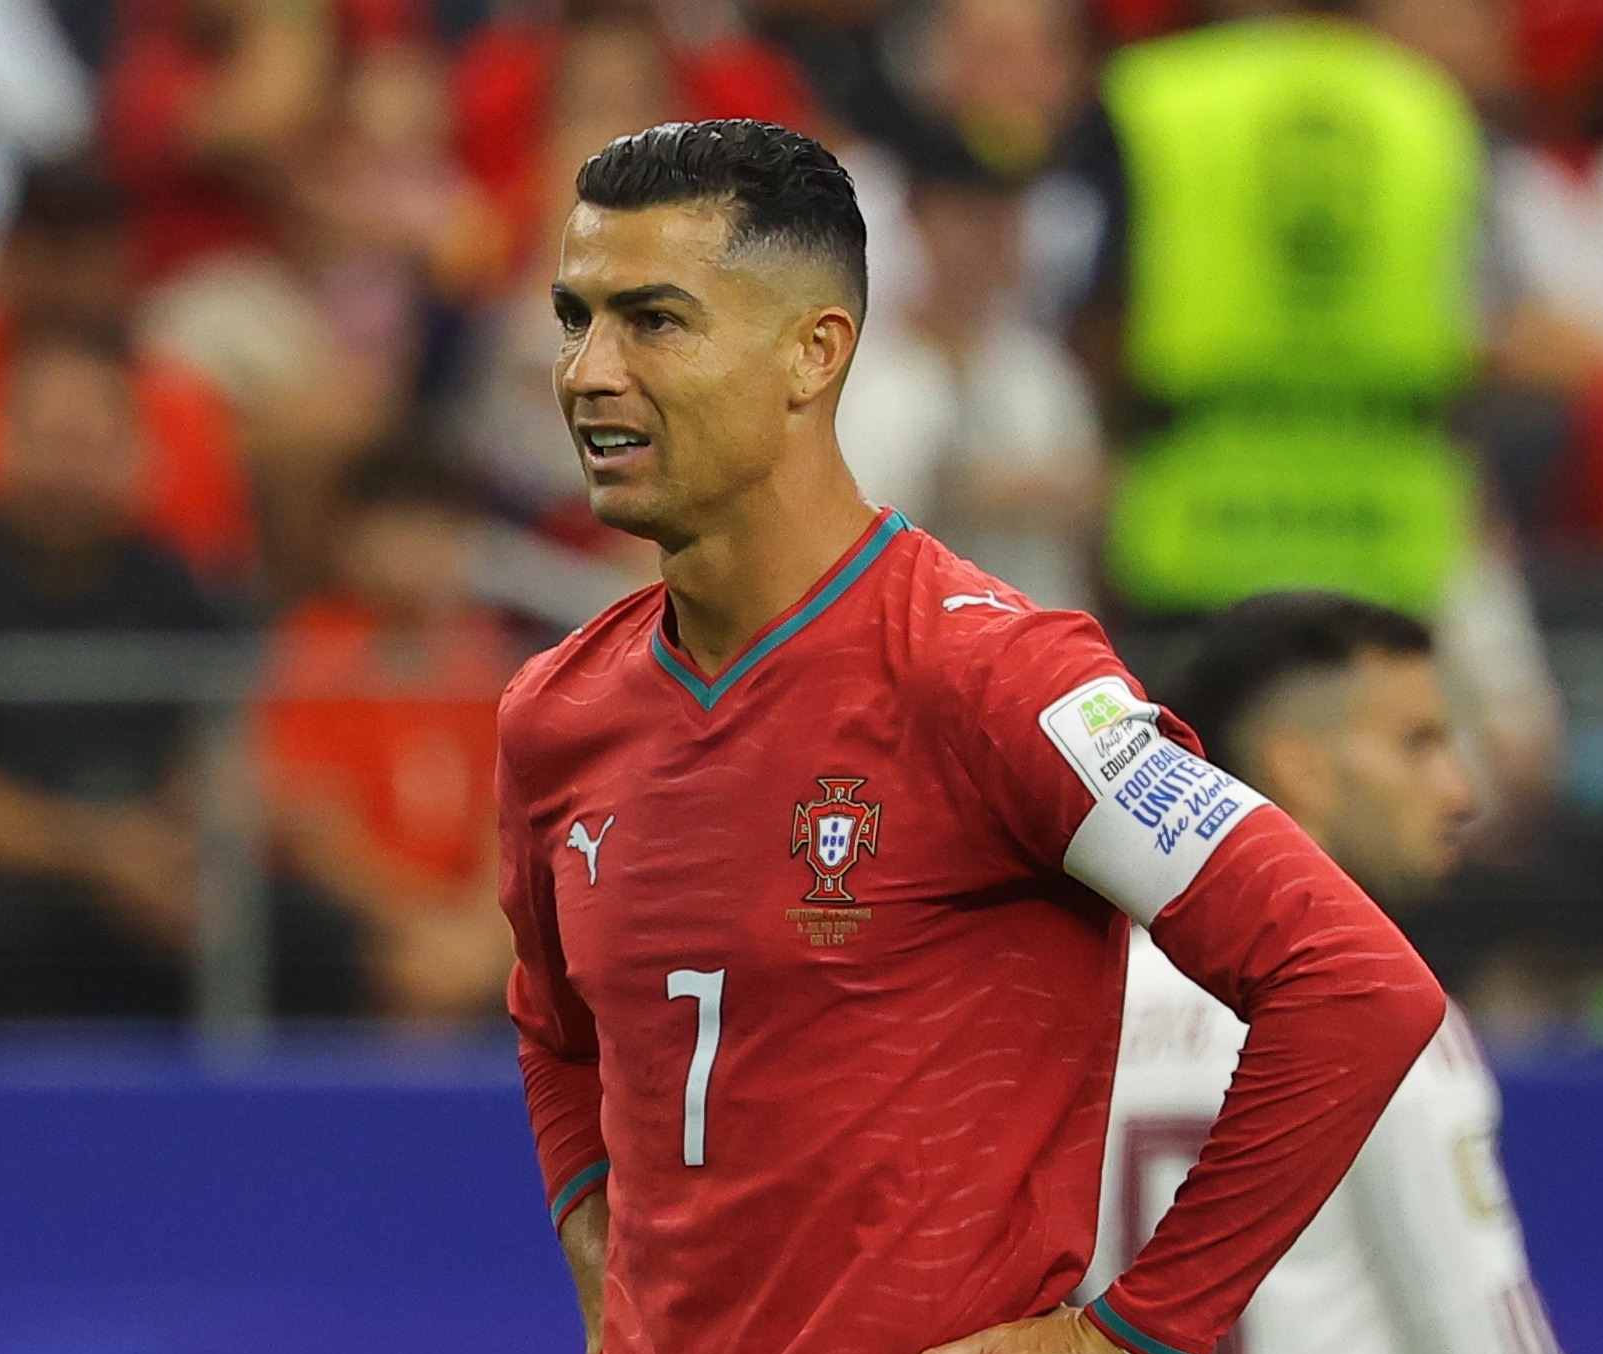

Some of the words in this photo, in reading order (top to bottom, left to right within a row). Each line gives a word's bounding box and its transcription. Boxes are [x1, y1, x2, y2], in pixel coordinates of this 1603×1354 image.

[1095, 727, 1124, 758] Unite
[1100, 727, 1152, 782] EDUCATION
[1114, 743, 1188, 811] FOOTBALL
[1132, 757, 1214, 828] UNITES
[1154, 816, 1189, 855] the
[1197, 799, 1238, 838] FIFA
[666, 968, 726, 1166] 7
